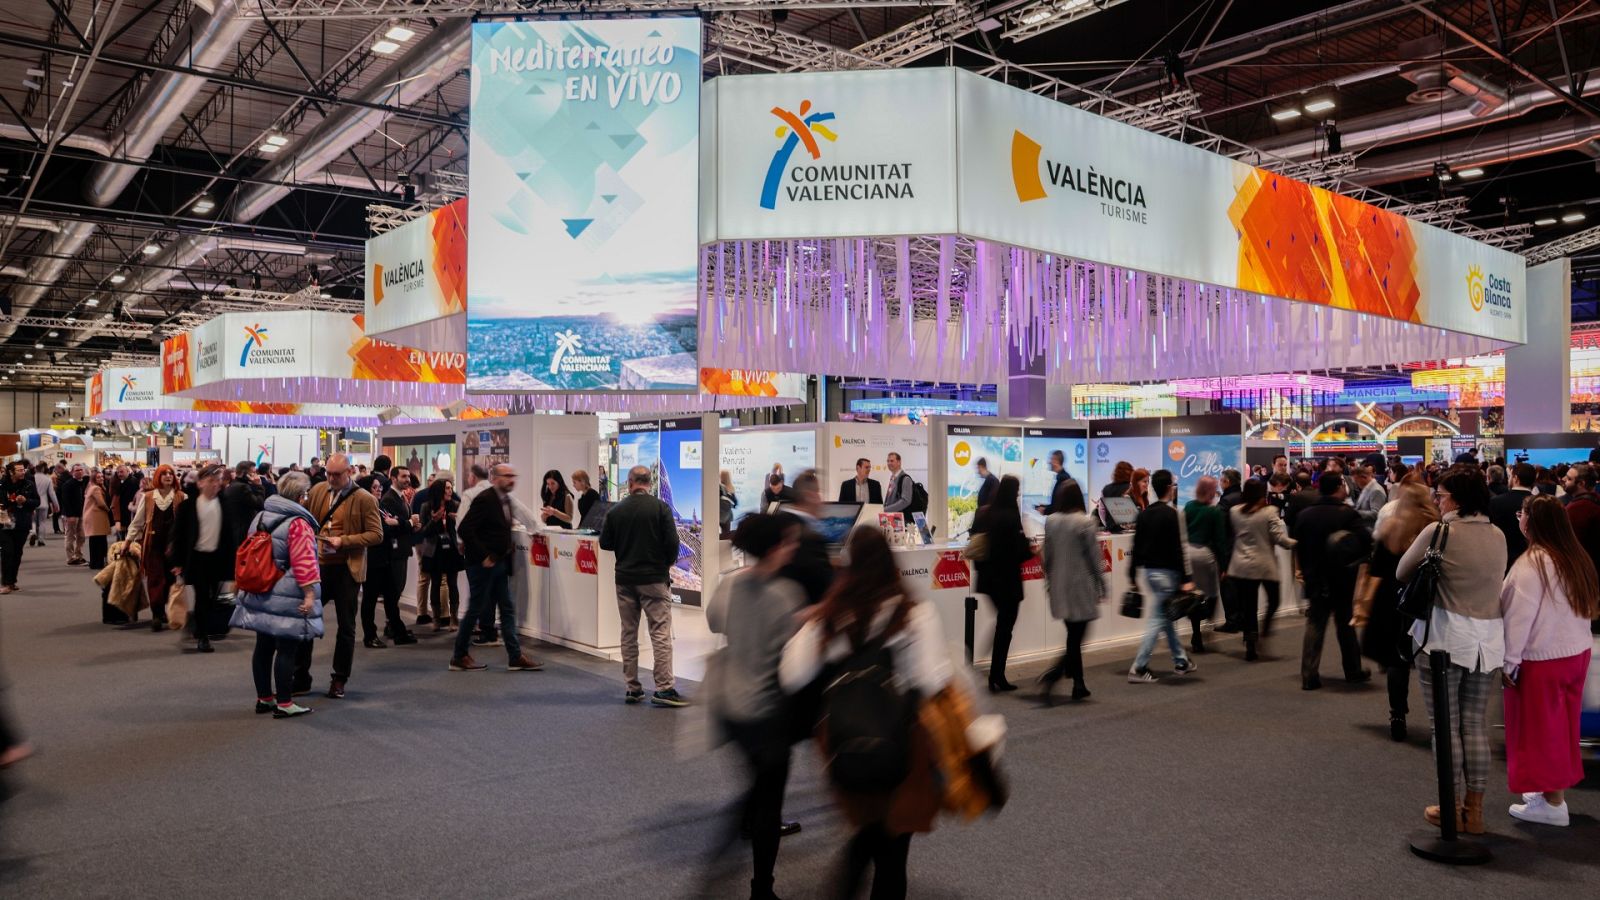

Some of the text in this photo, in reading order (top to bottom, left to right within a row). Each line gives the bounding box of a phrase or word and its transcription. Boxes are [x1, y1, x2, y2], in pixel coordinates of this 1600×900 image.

[565, 74, 598, 101] EN
[791, 163, 912, 182] COMUNITAT
[786, 183, 914, 201] VALENCIANA
[1046, 160, 1147, 208] VALÈNCIA
[1100, 202, 1147, 225] TURISME
[384, 259, 424, 287] VALÈNCIA
[403, 278, 424, 292] TURISME
[1489, 273, 1511, 293] Costa
[1485, 288, 1511, 309] Blanca
[250, 356, 296, 364] VALENCIANA
[410, 352, 426, 365] EN
[561, 363, 611, 372] VALENCIANA
[563, 355, 611, 364] COMUNITAT
[1347, 388, 1397, 398] MANCHA
